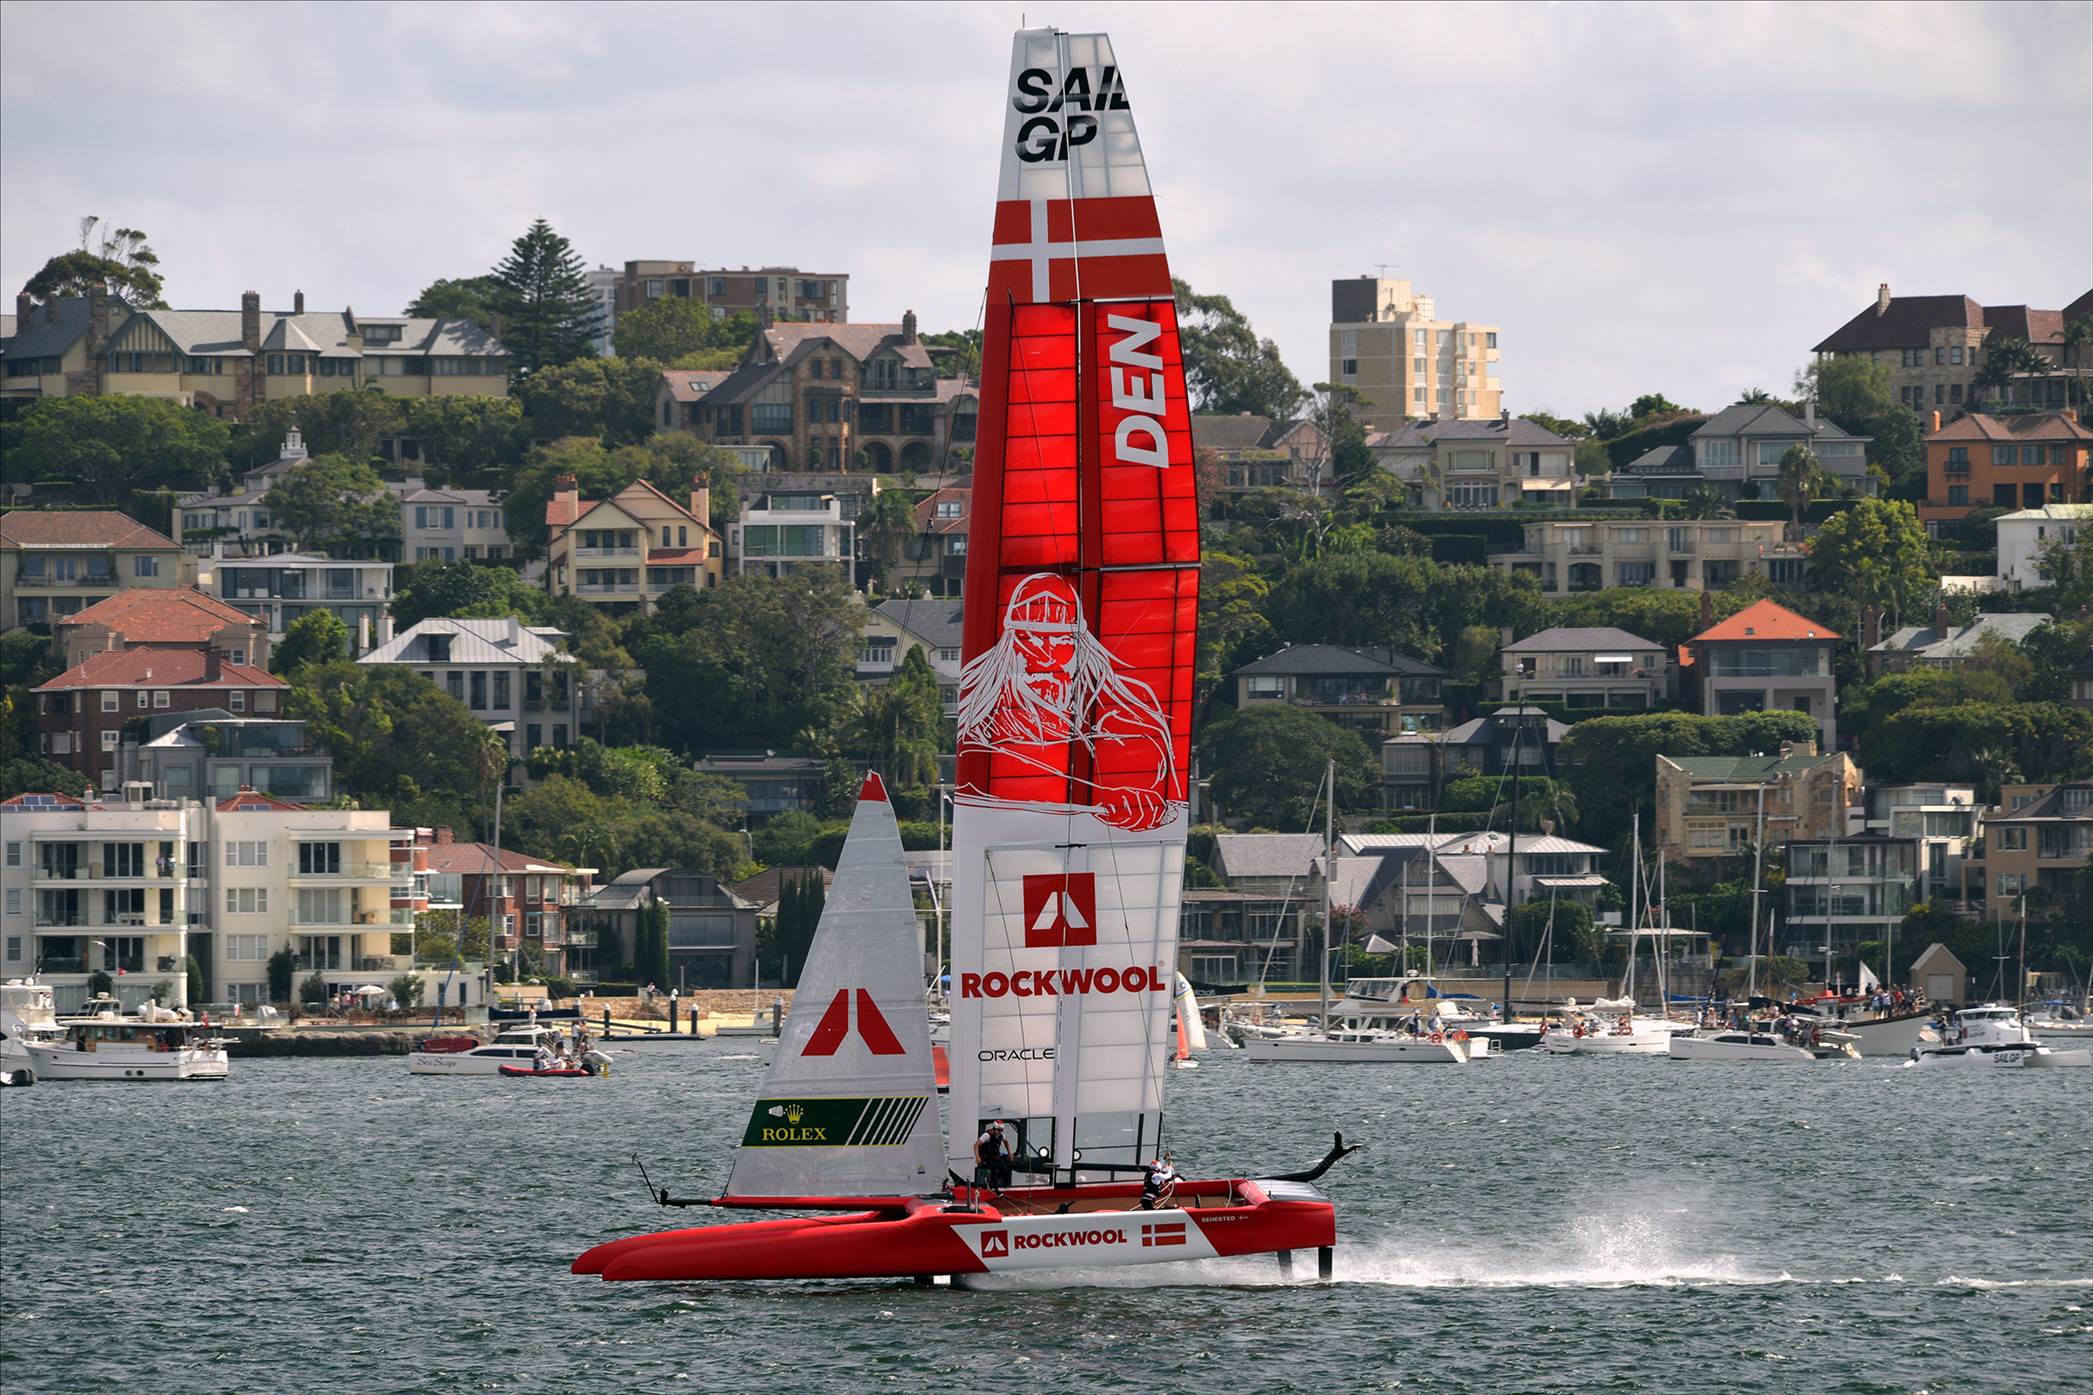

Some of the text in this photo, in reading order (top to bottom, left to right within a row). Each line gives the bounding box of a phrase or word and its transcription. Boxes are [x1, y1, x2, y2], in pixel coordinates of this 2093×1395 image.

[1013, 66, 1130, 114] SAIL
[1015, 115, 1098, 163] GP
[1108, 314, 1169, 468] DEN
[961, 966, 1166, 999] ROCKWOOL
[978, 1048, 1055, 1062] ORACLE
[762, 1128, 827, 1141] ROLEX
[1014, 1229, 1127, 1250] ROCKWOOL
